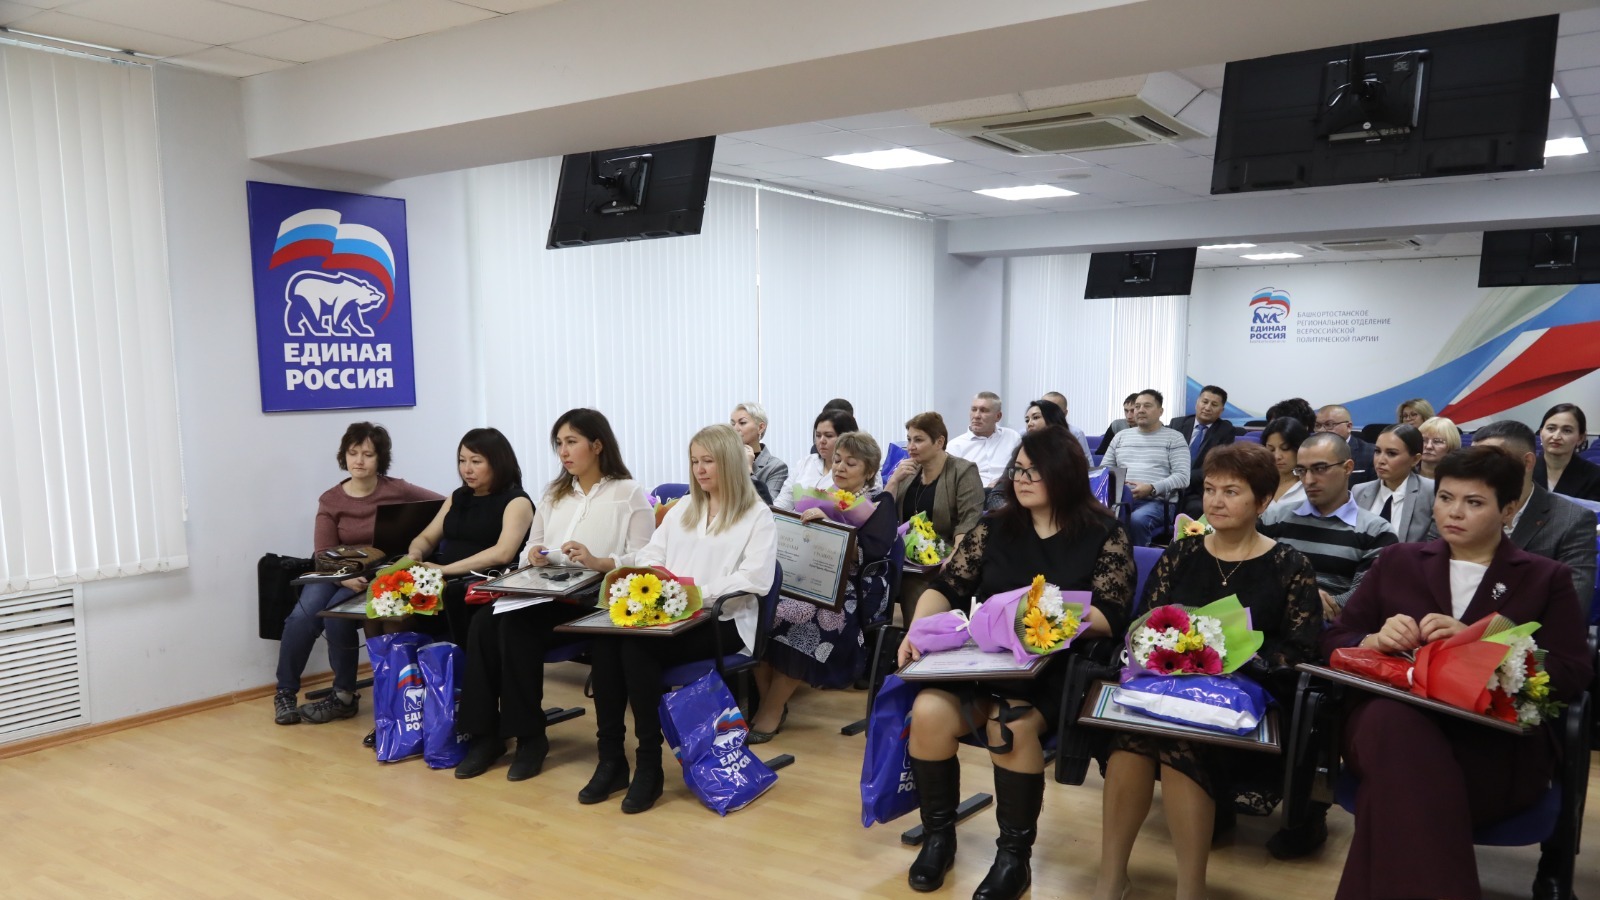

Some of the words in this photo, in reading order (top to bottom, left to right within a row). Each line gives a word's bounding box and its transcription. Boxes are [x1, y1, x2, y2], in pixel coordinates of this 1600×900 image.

[1297, 310, 1369, 318] БАШКОРТОСТАНСКОЕ
[1350, 318, 1391, 326] ОТДЕЛЕНИЕ
[1250, 325, 1287, 333] ЕДИНАЯ
[1296, 327, 1355, 335] ВСЕРОССИЙСКОЙ
[1250, 332, 1286, 340] РОССИЯ
[1296, 335, 1350, 343] ПОЛИТИЧЕСКОЙ
[283, 342, 392, 366] ЕДИНАЯ
[285, 367, 394, 391] РОССИЯ
